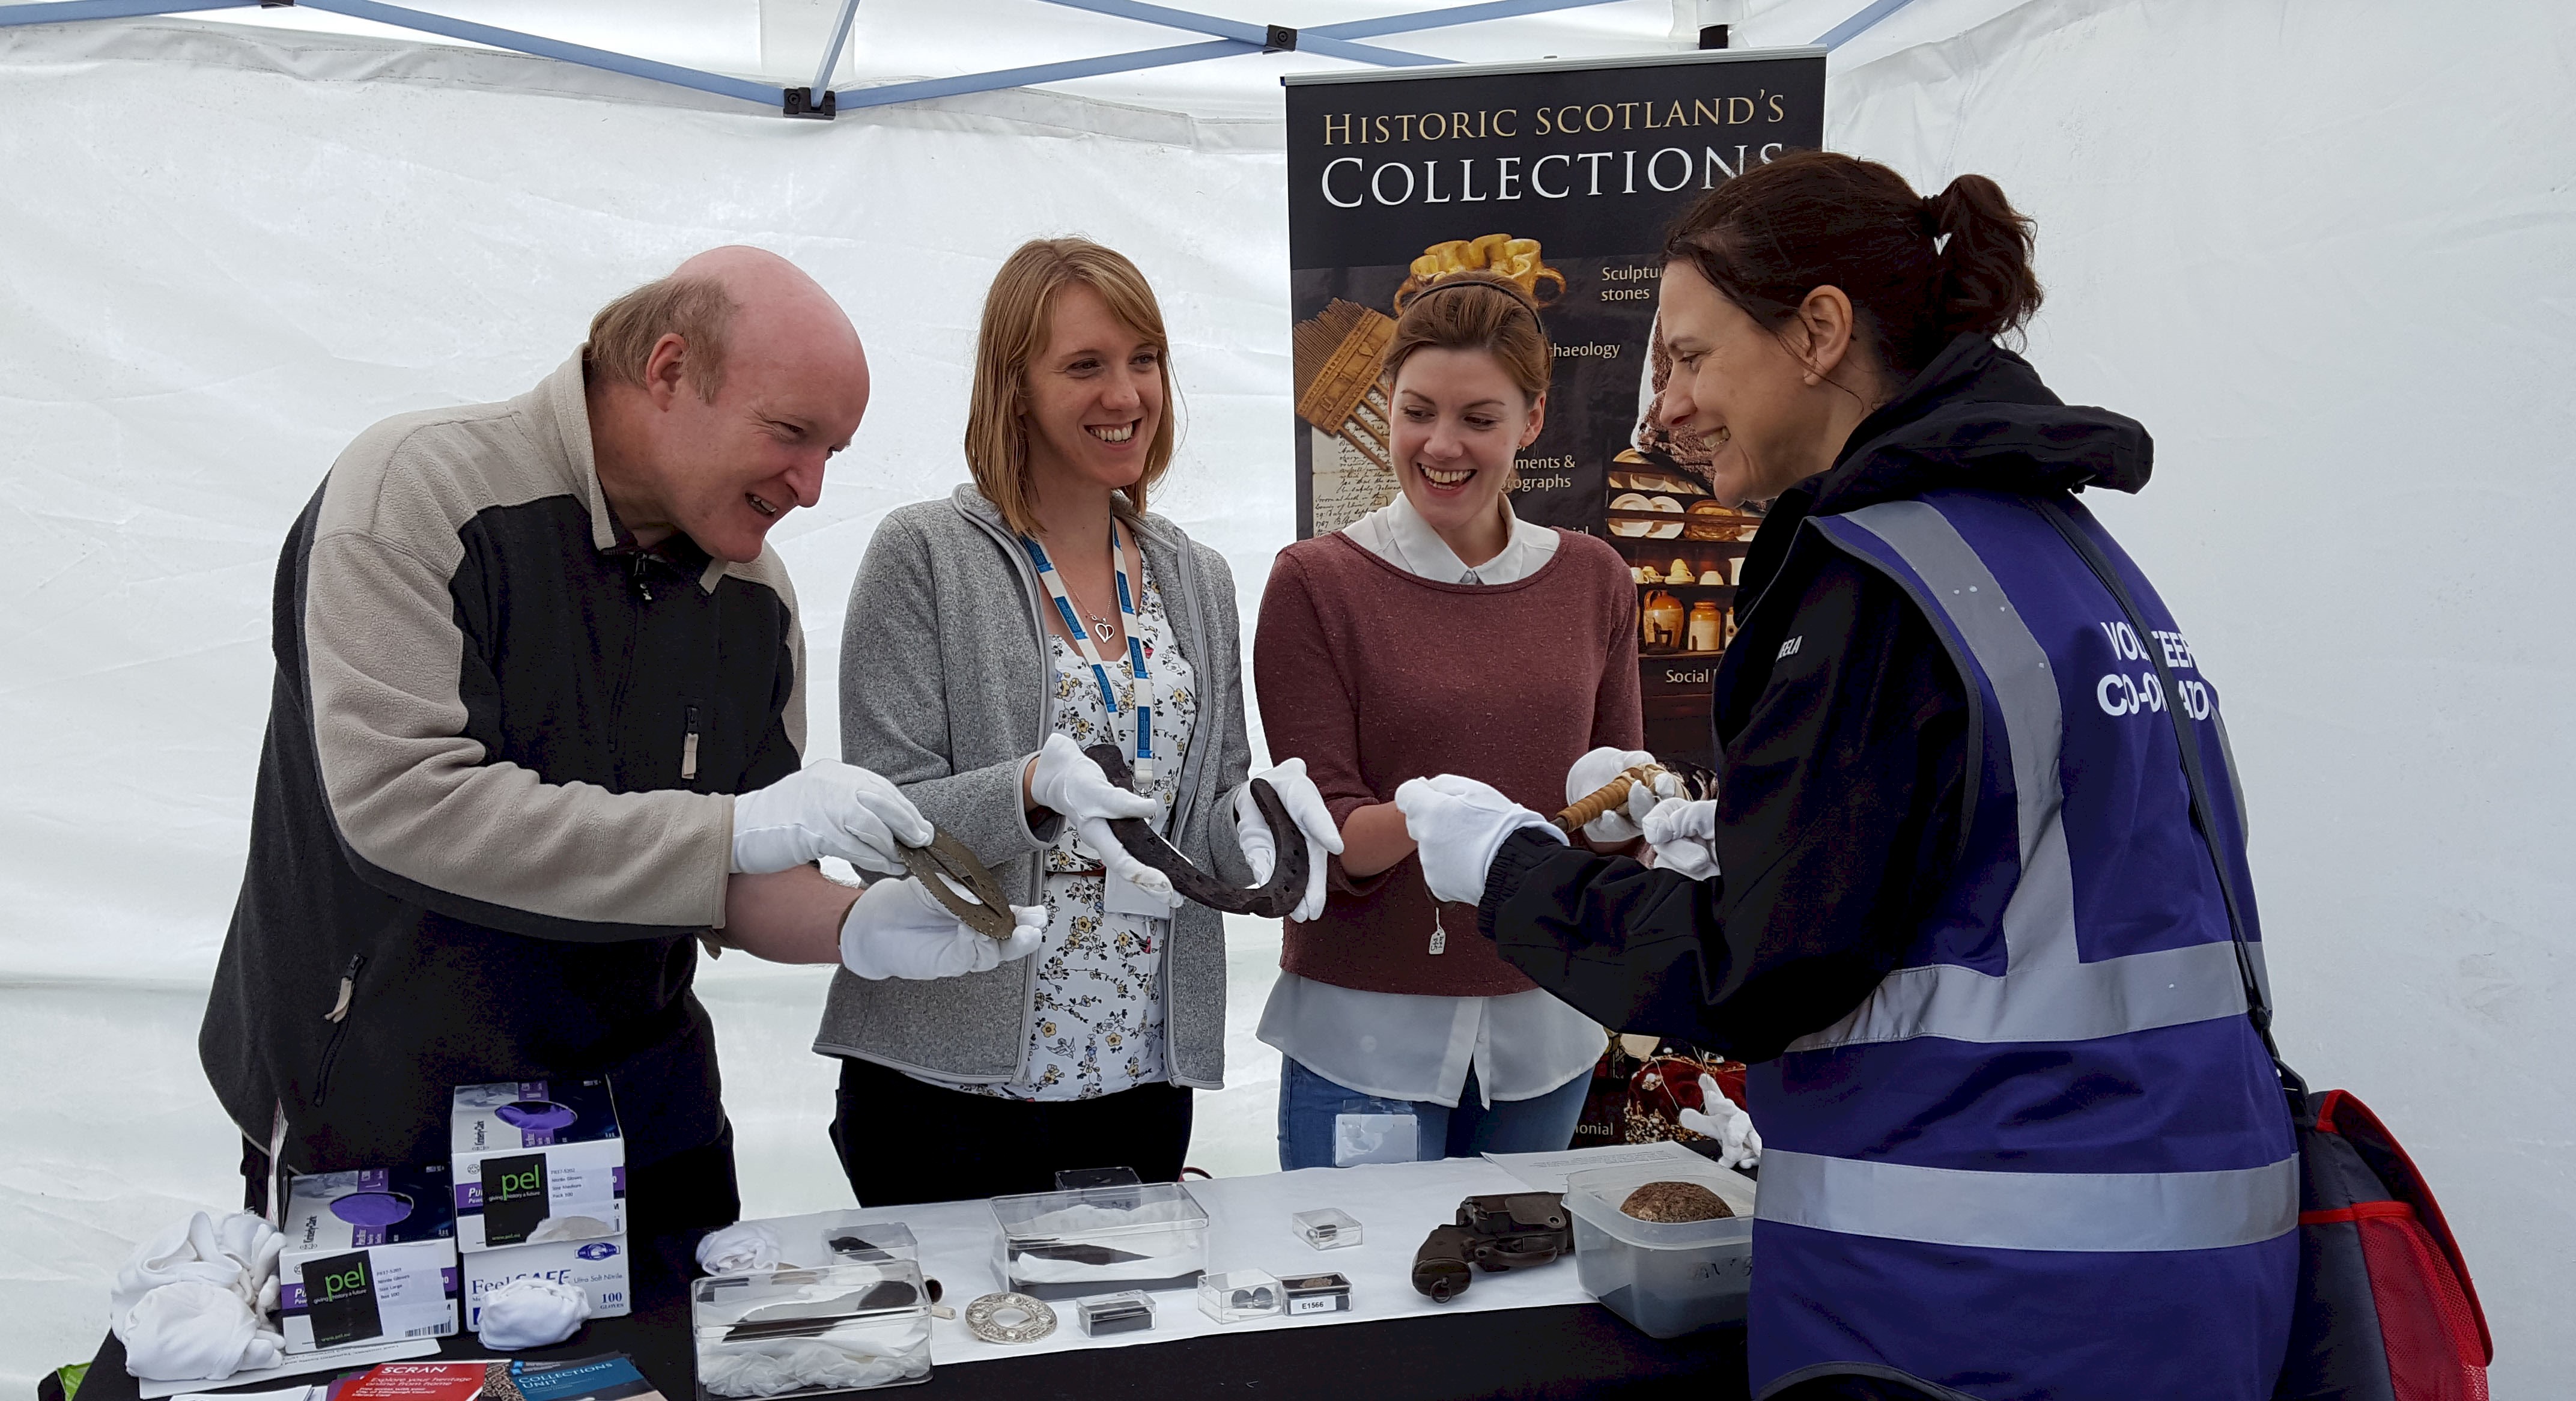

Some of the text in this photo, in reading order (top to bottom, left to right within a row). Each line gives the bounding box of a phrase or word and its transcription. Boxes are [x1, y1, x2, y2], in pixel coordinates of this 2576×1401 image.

[1323, 89, 1784, 145] HISTORIC SCOTLAND'S
[1601, 288, 1650, 301] stones
[1515, 455, 1575, 469] ments &
[1502, 473, 1571, 491] ographs
[2100, 621, 2195, 668] VOLEER
[1666, 669, 1709, 682] Social
[502, 1164, 539, 1201] pel
[325, 1262, 366, 1302] pel
[603, 1272, 622, 1281] Nitrile
[472, 1275, 509, 1295] Feel
[601, 1292, 622, 1304] 100
[1301, 1301, 1324, 1310] E1566
[381, 1366, 448, 1375] SCRAN
[518, 1362, 613, 1384] COLLECTIONS
[521, 1379, 558, 1388] UNIT
